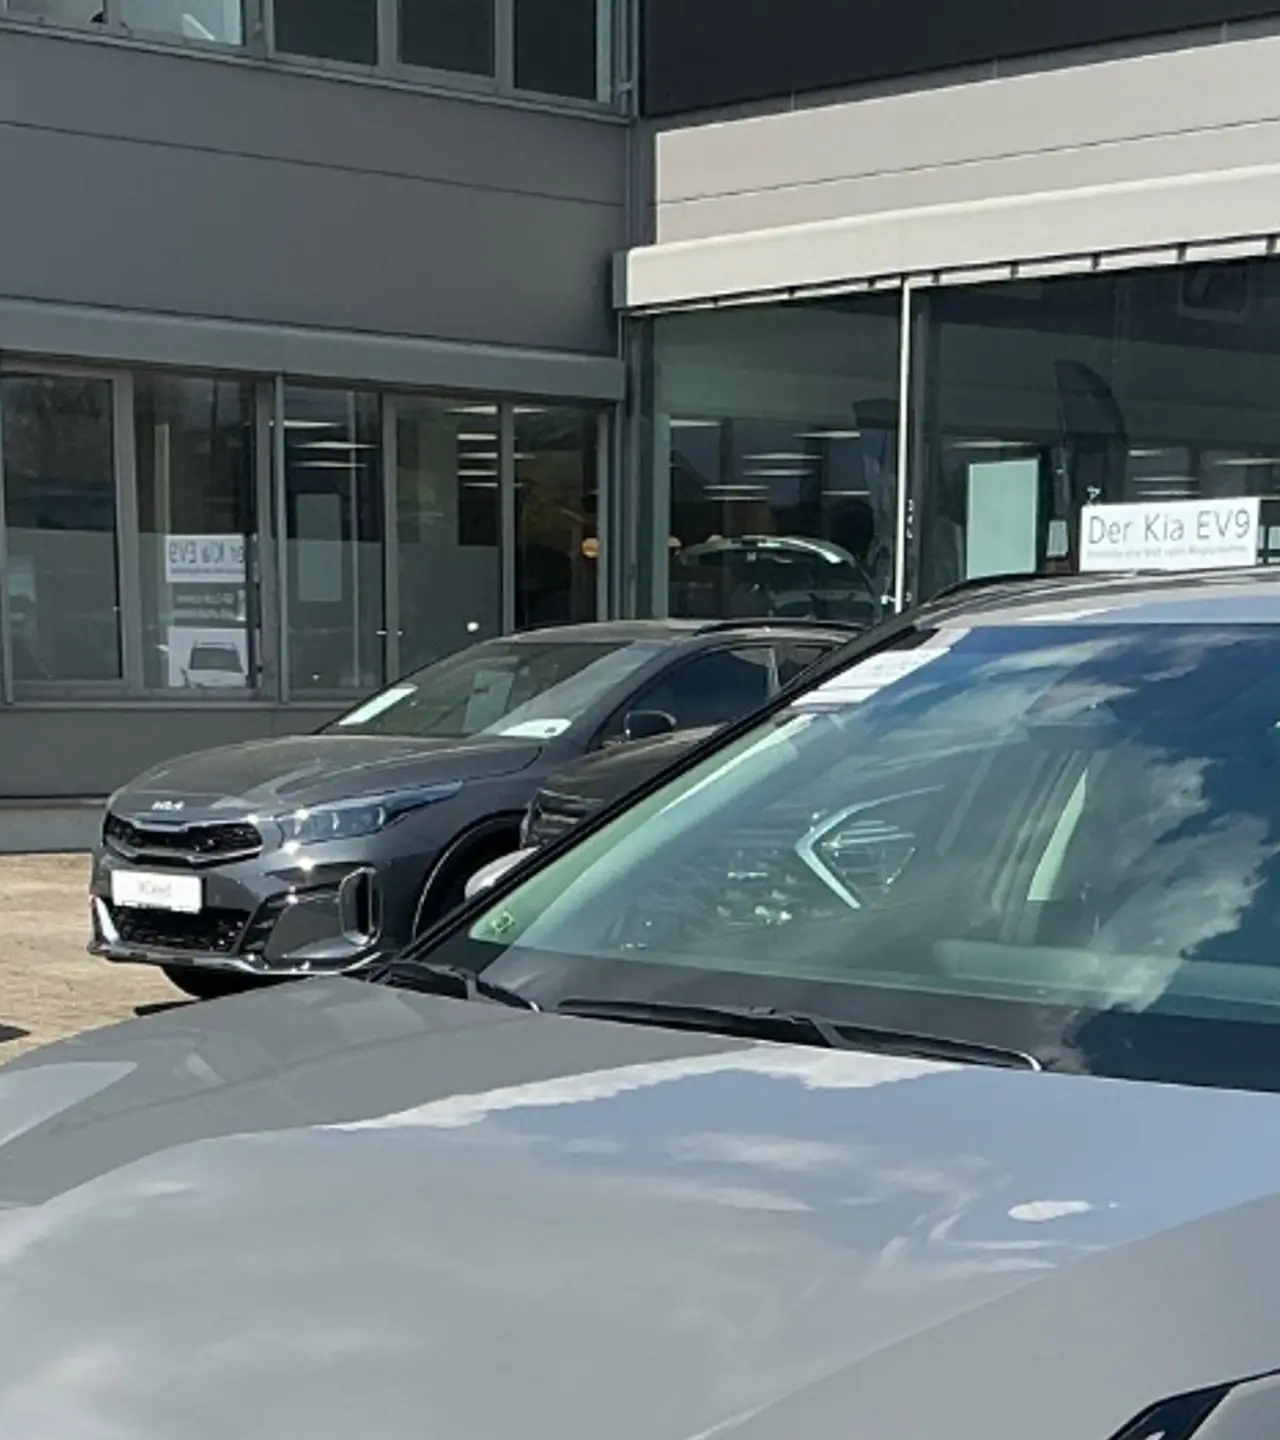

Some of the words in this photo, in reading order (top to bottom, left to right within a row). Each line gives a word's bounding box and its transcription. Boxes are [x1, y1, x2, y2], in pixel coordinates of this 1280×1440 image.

[1088, 514, 1133, 545] Der
[1144, 511, 1185, 542] Kia
[1197, 508, 1251, 540] EV9
